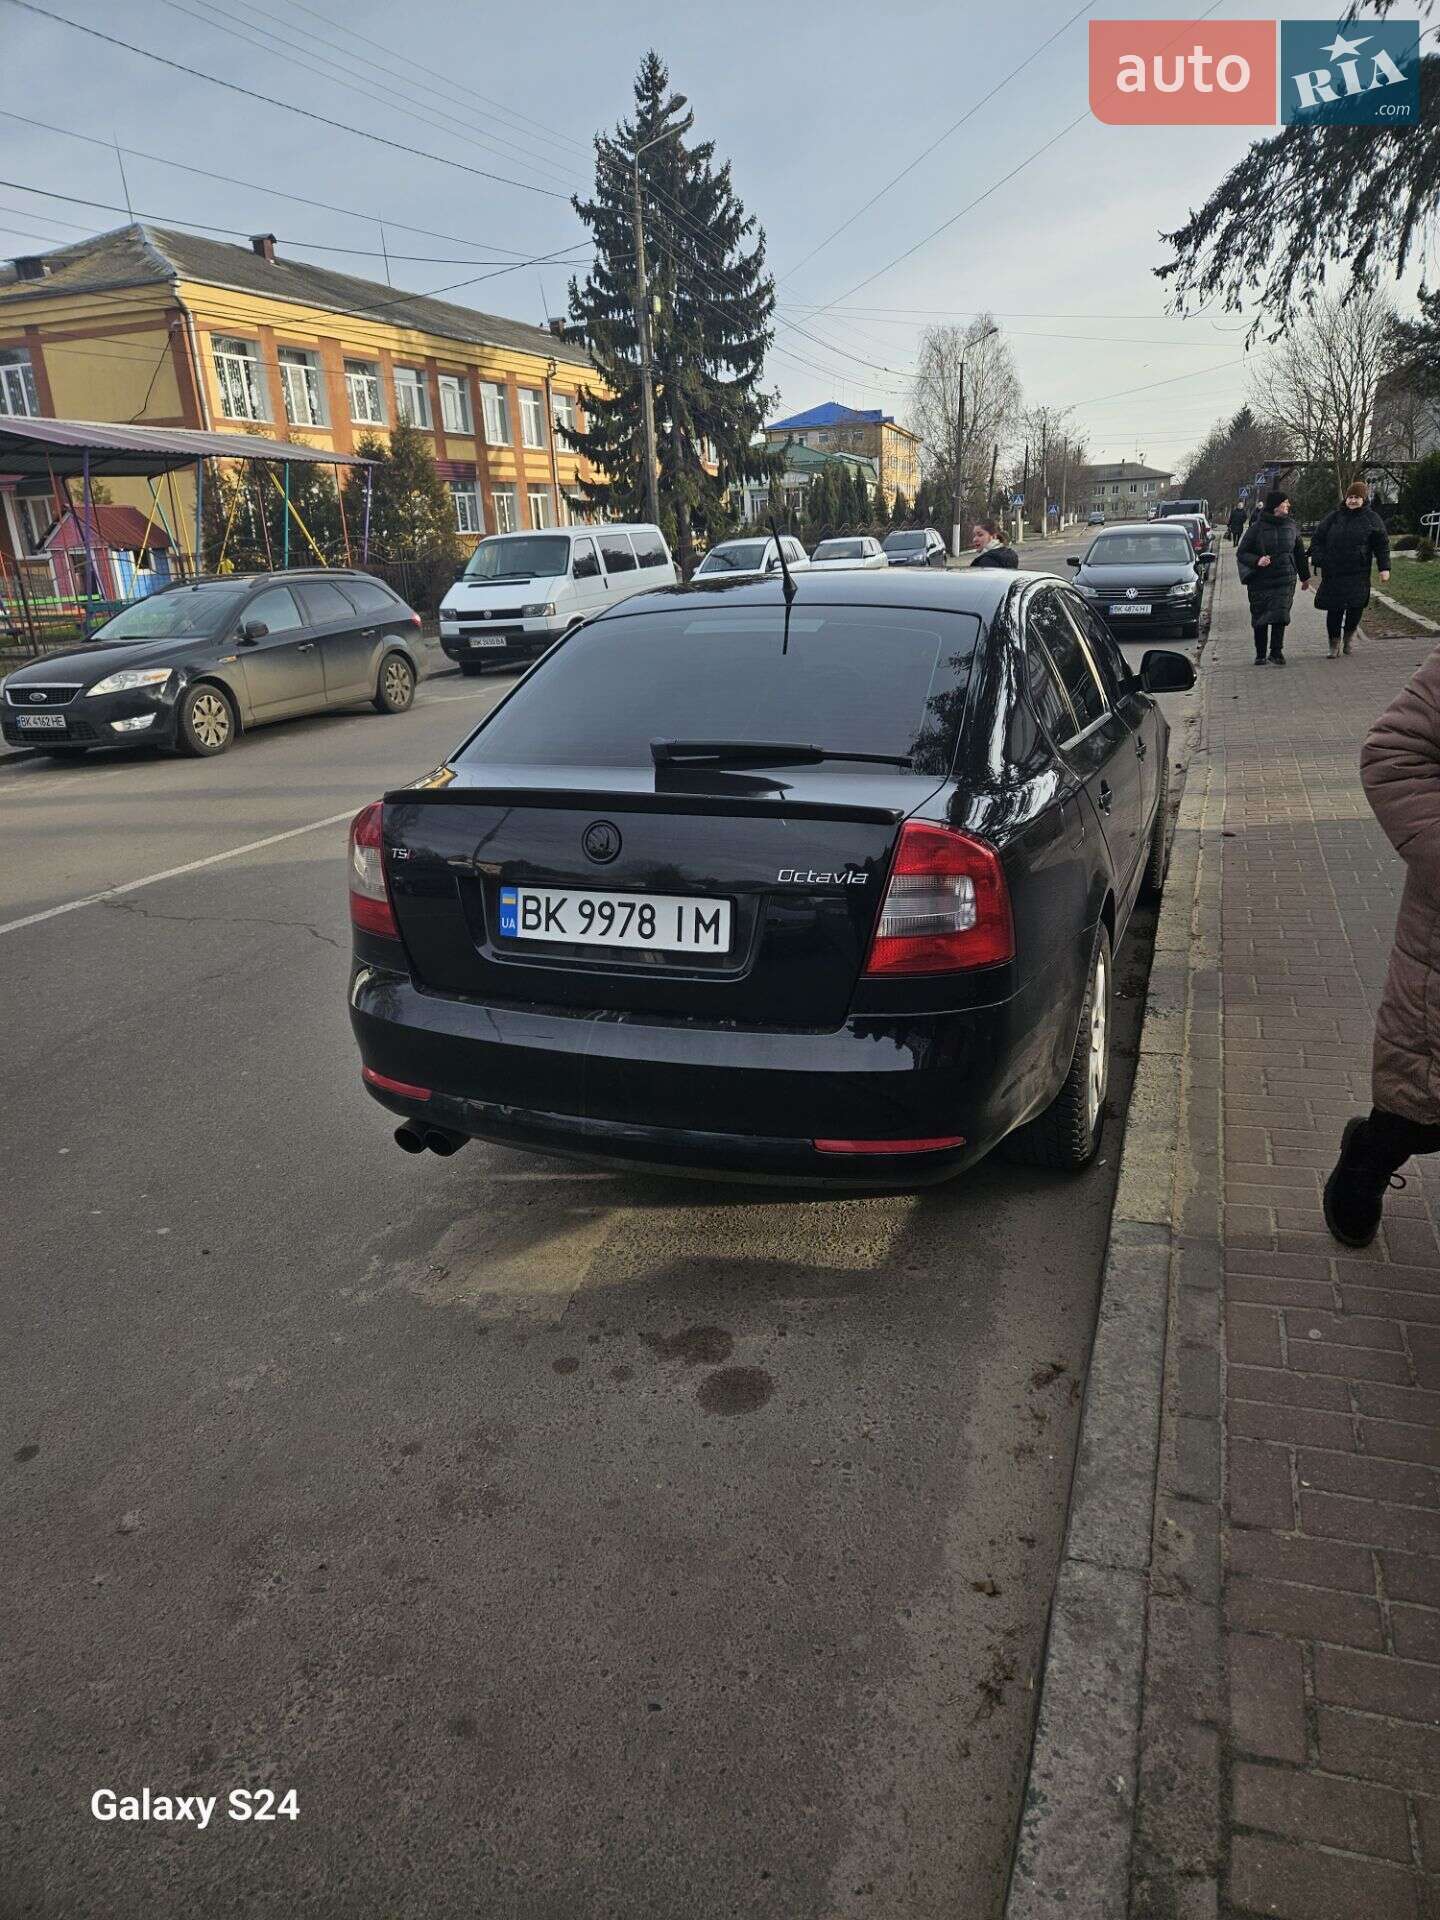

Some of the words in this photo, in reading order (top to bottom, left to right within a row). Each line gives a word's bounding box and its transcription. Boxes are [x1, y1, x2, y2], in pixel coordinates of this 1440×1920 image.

[21, 716, 32, 727] BK
[32, 716, 51, 727] 4162
[52, 716, 65, 727] HE
[777, 869, 870, 885] Octavia
[501, 917, 516, 930] UA
[521, 895, 568, 934] BK
[577, 899, 657, 940] 9978
[676, 905, 721, 946] IM
